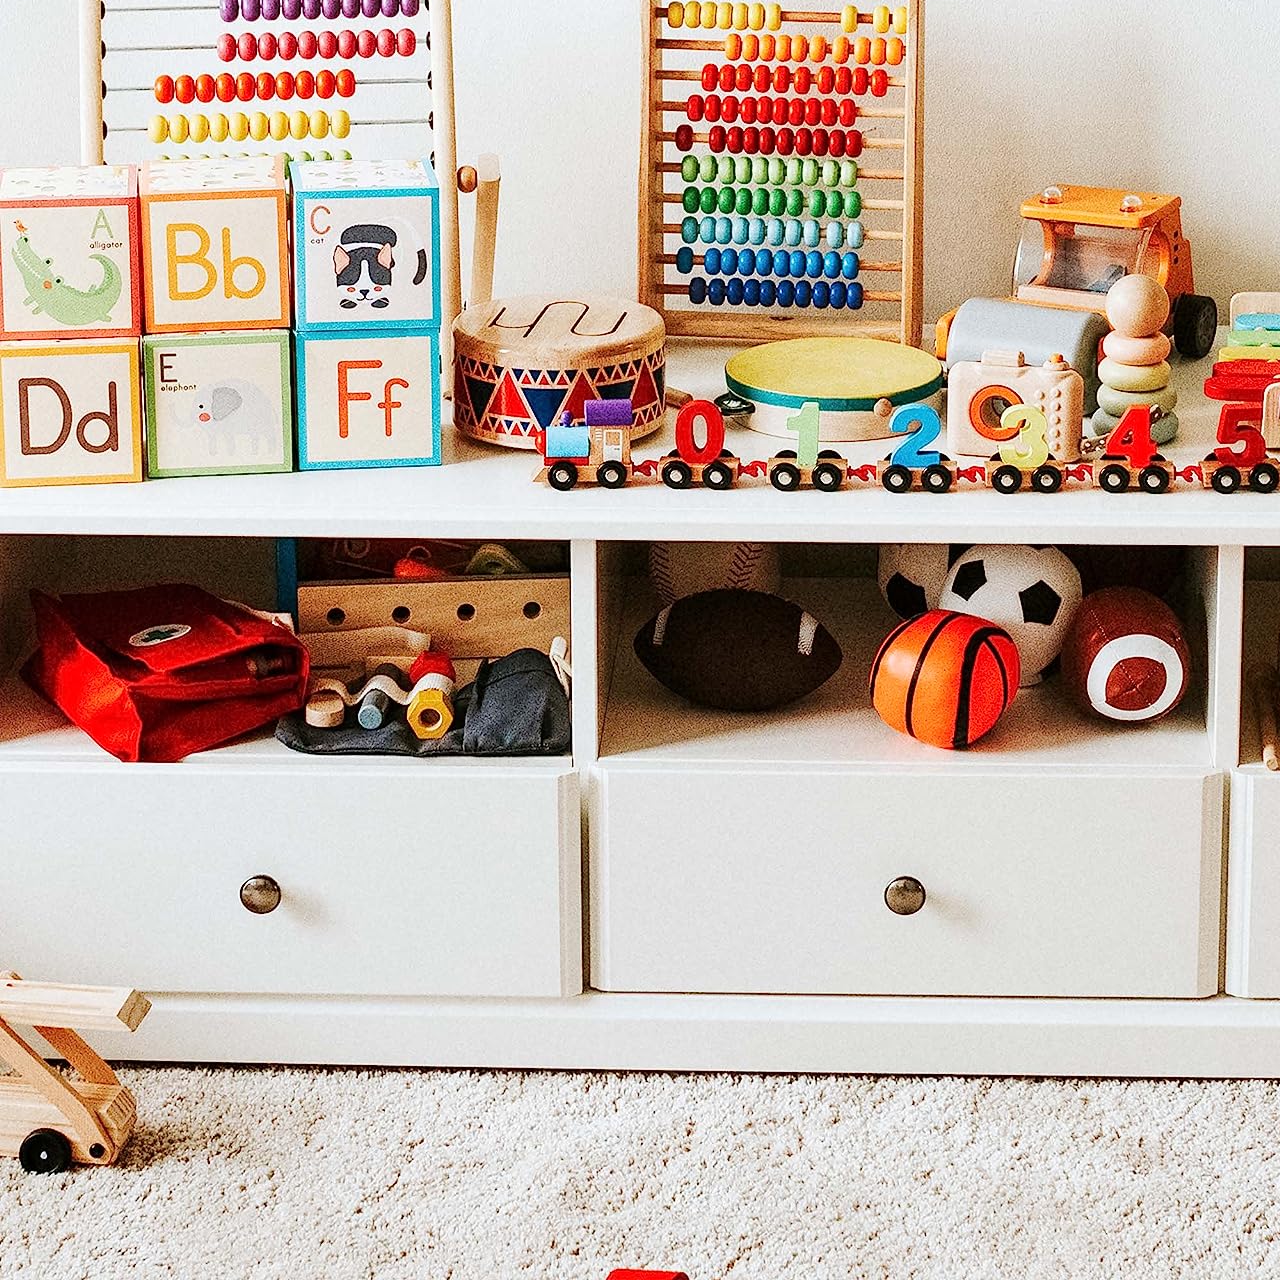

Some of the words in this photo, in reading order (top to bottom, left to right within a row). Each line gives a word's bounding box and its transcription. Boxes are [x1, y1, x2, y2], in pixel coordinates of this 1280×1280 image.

[89, 241, 123, 251] alligator
[91, 208, 114, 239] A
[310, 205, 331, 235] C
[166, 223, 267, 301] Bb
[160, 353, 178, 383] E
[160, 384, 197, 392] elephant
[337, 360, 409, 439] Ff
[18, 377, 119, 456] Dd
[675, 399, 726, 464] 0
[786, 401, 820, 468] 1
[888, 403, 942, 469] 2
[998, 404, 1051, 469] 3
[1106, 404, 1158, 468] 4
[1215, 404, 1269, 468] 5
